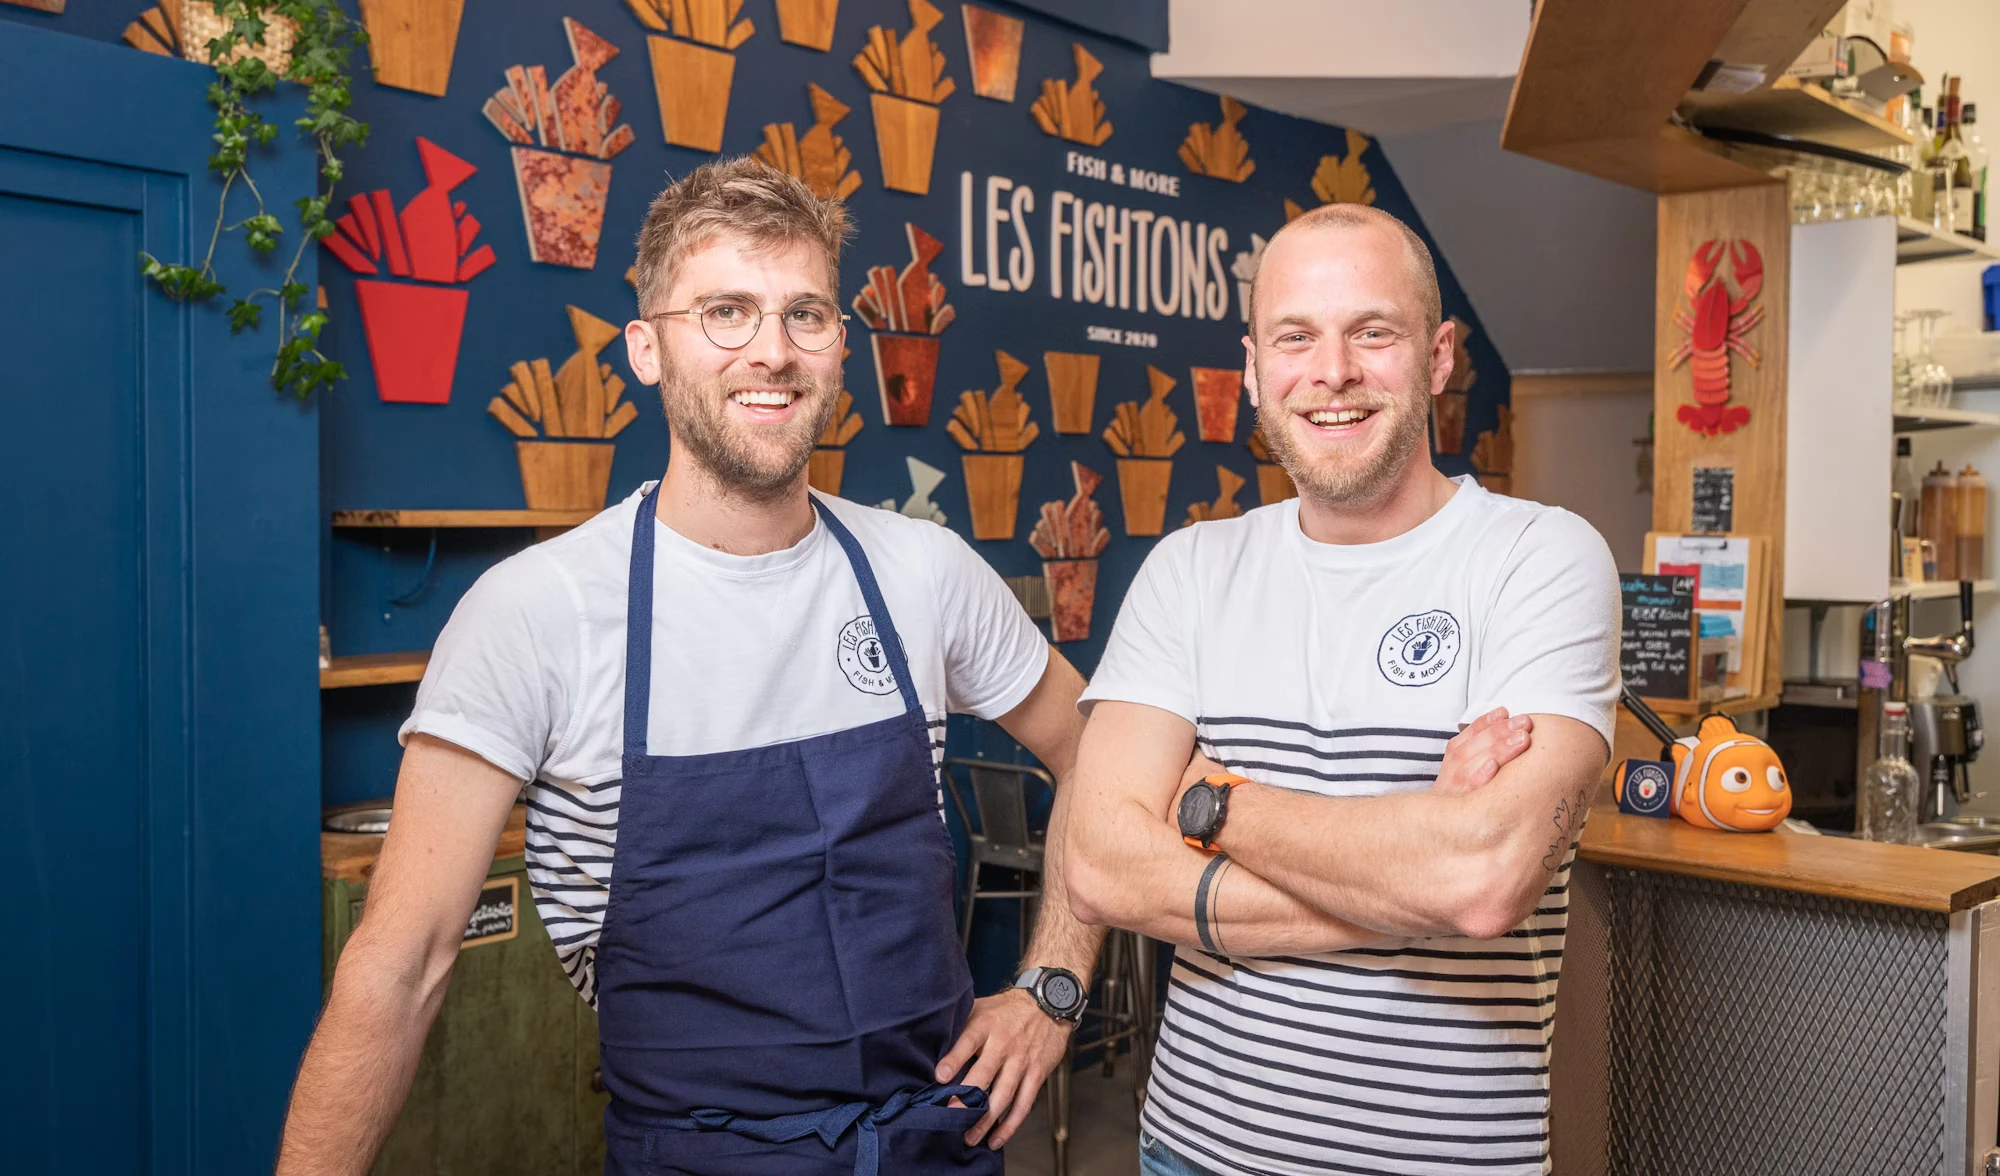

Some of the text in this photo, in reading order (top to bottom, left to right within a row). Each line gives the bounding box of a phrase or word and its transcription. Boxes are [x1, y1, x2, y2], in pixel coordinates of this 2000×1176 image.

[1067, 151, 1180, 197] FISH & MORE
[961, 171, 1228, 321] LES FISHTONS
[1087, 325, 1121, 345] SINCE
[842, 620, 877, 651] LES FISH
[1391, 615, 1455, 643] LES FISHTONS
[853, 670, 875, 687] FISH
[1388, 660, 1406, 678] FISH
[1420, 659, 1446, 678] MORE
